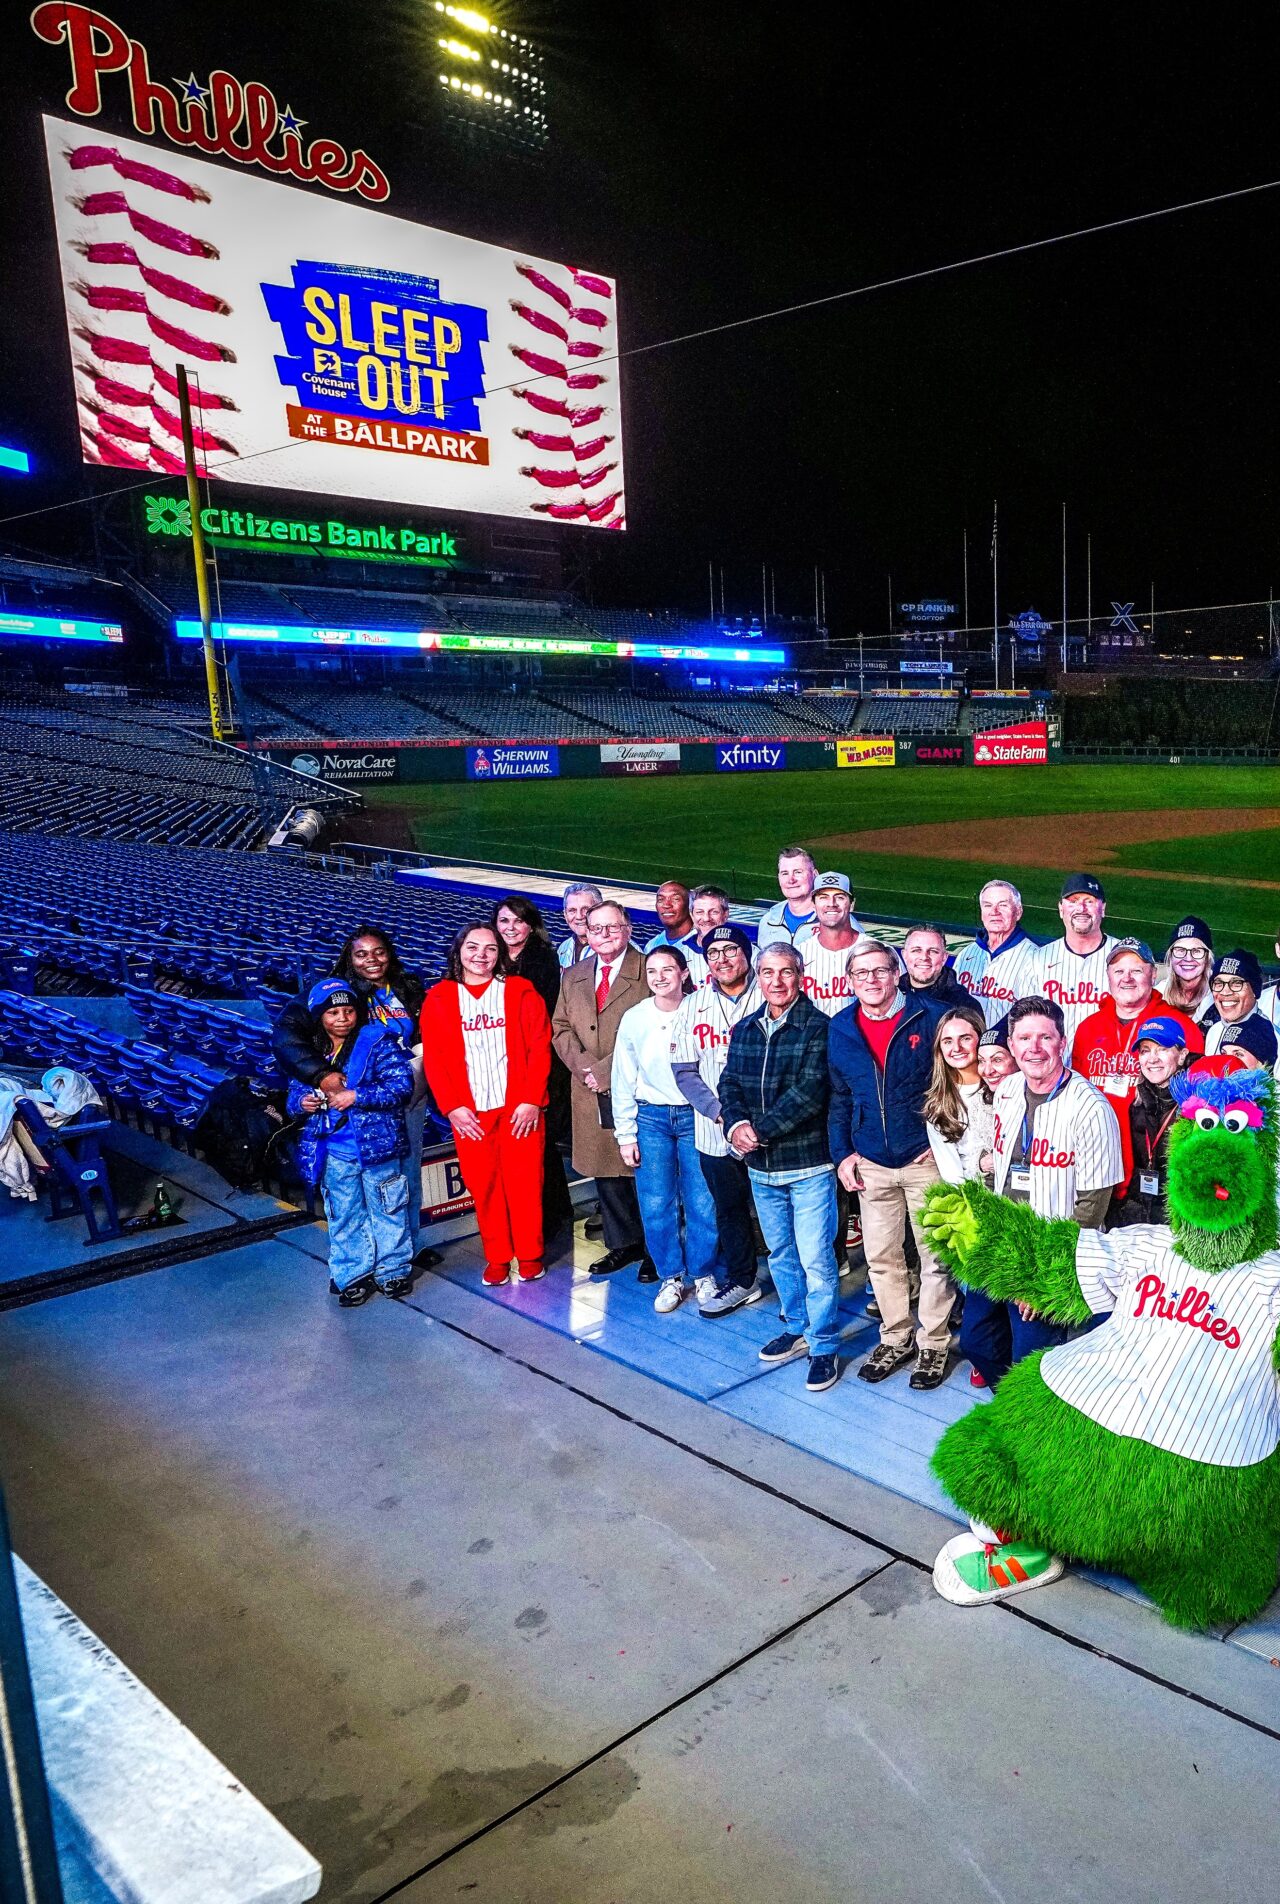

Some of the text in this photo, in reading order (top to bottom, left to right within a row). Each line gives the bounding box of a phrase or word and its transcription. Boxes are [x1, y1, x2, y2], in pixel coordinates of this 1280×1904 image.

[30, 1, 391, 202] Phillies
[303, 286, 462, 368] SLEEP
[302, 372, 356, 391] Covenant
[357, 354, 449, 420] OUT
[312, 385, 347, 398] House
[306, 414, 323, 424] AT
[301, 424, 327, 437] THE
[334, 418, 478, 460] BALLPARK
[200, 509, 457, 556] Citizens Bank Park
[616, 745, 666, 760] Yuengling
[900, 742, 912, 750] 387
[916, 748, 963, 759] GIANT
[322, 754, 396, 770] NovaCare
[493, 749, 549, 762] SHERWIN
[720, 744, 781, 767] xfinity
[1169, 756, 1180, 764] 401
[626, 762, 658, 772] LAGER
[324, 771, 394, 779] REHABILITATION
[1222, 957, 1240, 969] SLEEP
[1225, 965, 1238, 975] OUT
[958, 971, 1015, 1001] Phillies
[909, 1034, 920, 1049] P
[1133, 1274, 1241, 1350] Phillies
